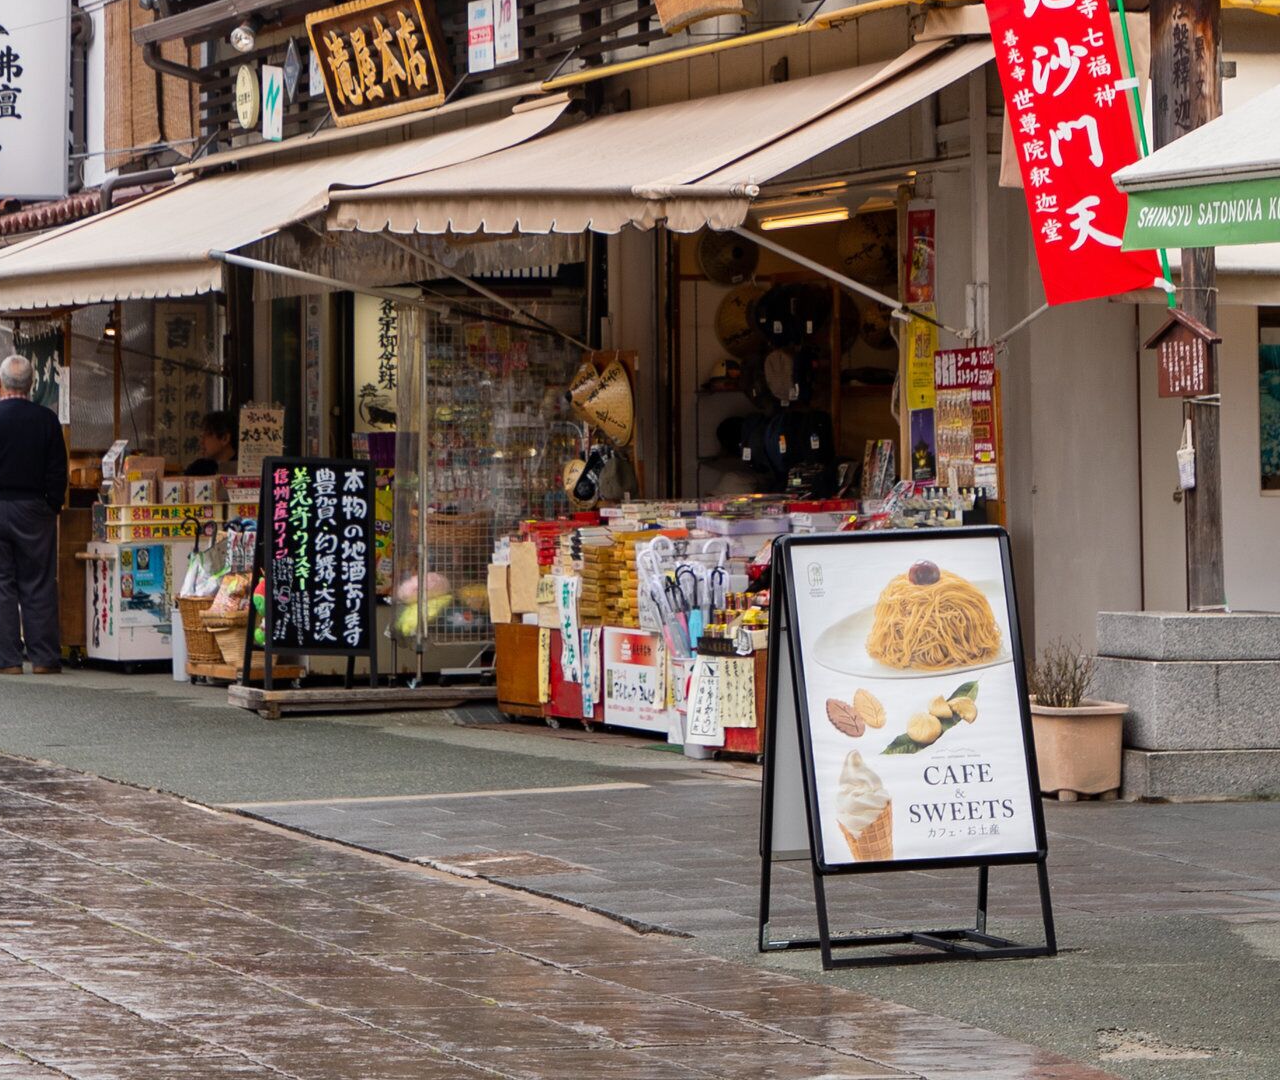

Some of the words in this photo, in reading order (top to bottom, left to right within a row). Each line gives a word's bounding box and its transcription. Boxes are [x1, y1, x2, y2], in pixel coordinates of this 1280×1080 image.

[1002, 29, 1063, 244] 善光寺世尊院釈迦堂
[1137, 204, 1193, 230] SHINSYU
[1198, 197, 1263, 225] SATONOKA
[273, 468, 290, 560] 信州産ワイン
[341, 468, 367, 646] 本物の地酒あります
[924, 763, 993, 785] CAFE
[955, 789, 965, 798] &
[909, 799, 1014, 823] SWEETS
